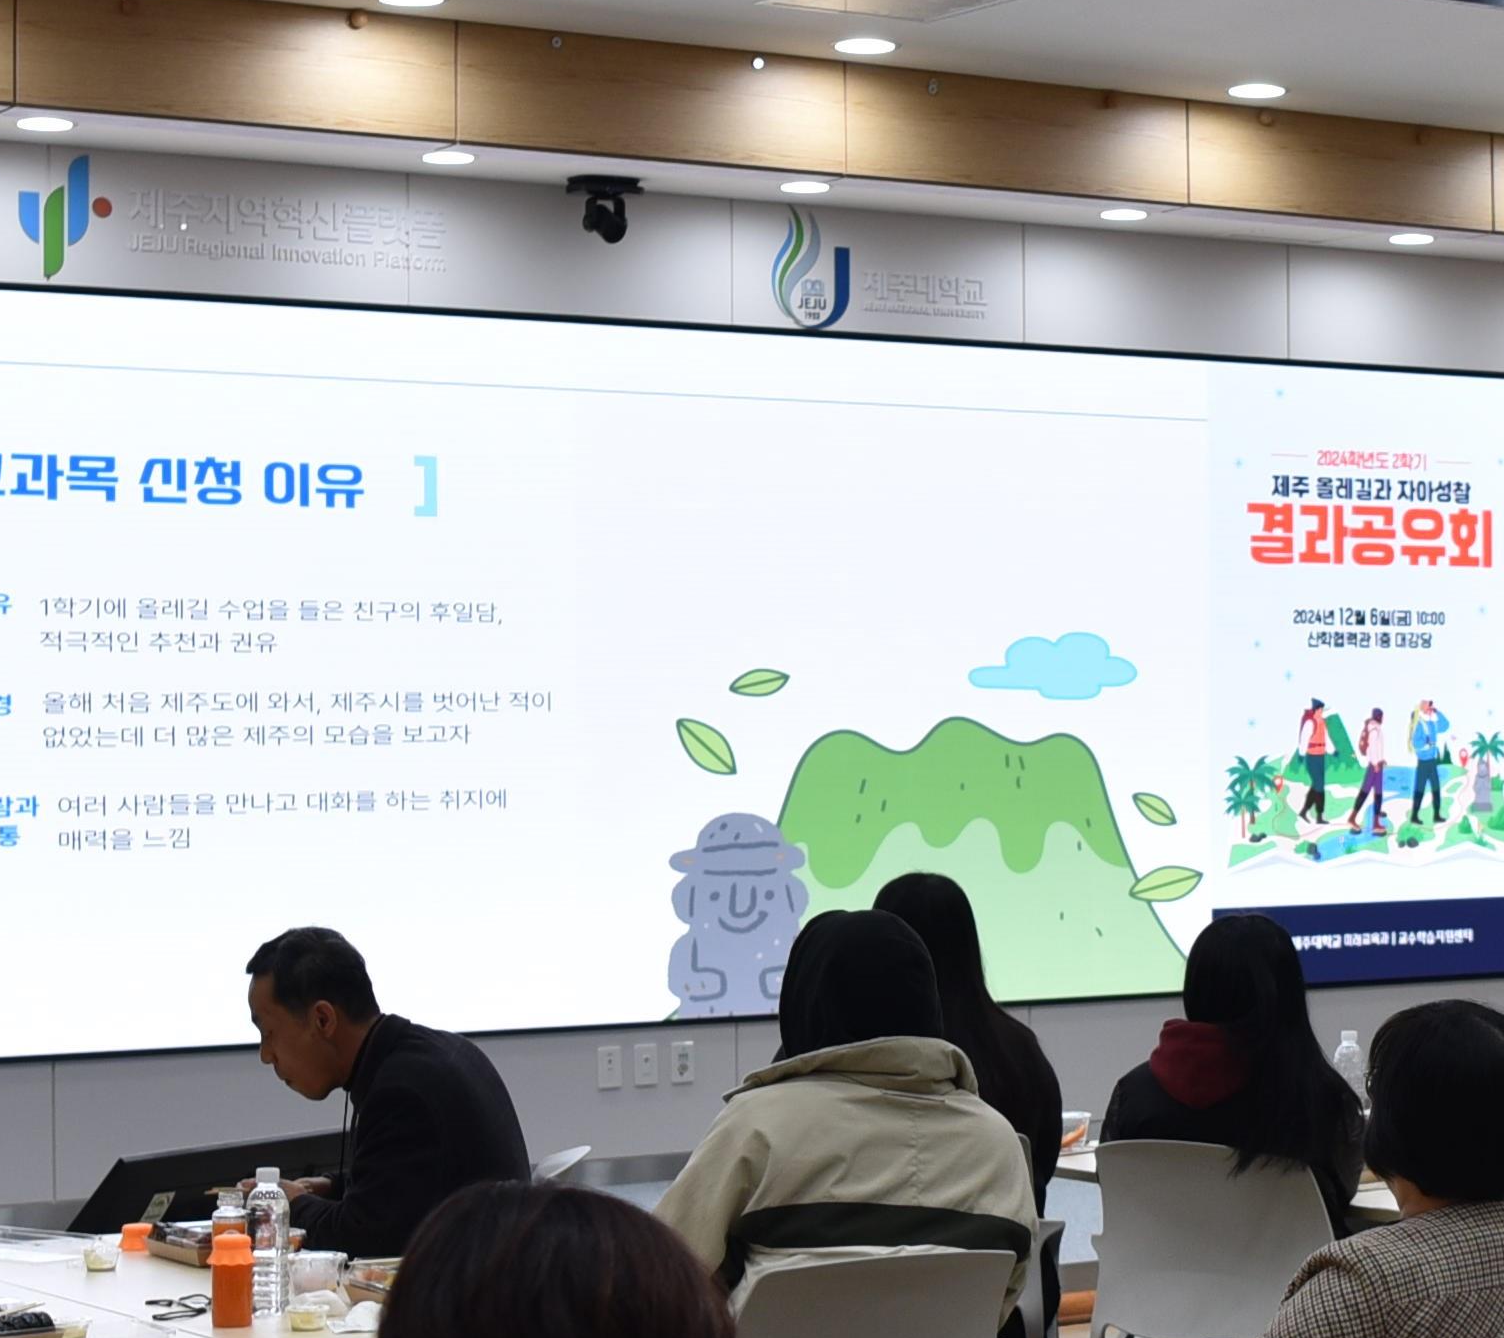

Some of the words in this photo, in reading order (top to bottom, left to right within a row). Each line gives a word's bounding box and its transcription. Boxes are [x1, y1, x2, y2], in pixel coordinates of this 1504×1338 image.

[129, 232, 178, 253] JEJU
[183, 235, 265, 261] Regional
[272, 243, 366, 268] Innovation
[864, 271, 988, 307] 제주대학교
[798, 296, 827, 311] JEJU
[1317, 449, 1389, 470] 2024학년도
[1392, 453, 1428, 472] 2학기
[139, 456, 243, 507] 신청
[263, 460, 365, 509] 이유
[1272, 474, 1310, 499] 제주
[1316, 476, 1392, 502] 올레길과
[1398, 479, 1471, 505] 자아성찰
[1247, 502, 1492, 568] 결과공유회
[40, 597, 127, 619] 1학기에
[136, 597, 209, 621] 올레길
[217, 598, 290, 622] 수업을
[298, 599, 344, 622] 들은
[353, 600, 420, 623] 친구의
[429, 601, 503, 626] 후일담,
[1293, 609, 1334, 626] 2024년
[1339, 607, 1366, 626] 12월
[1370, 607, 1412, 627] 6일(금)
[1416, 610, 1446, 626] 10:00
[40, 630, 139, 654] 적극적인
[149, 630, 222, 654] 추천과
[230, 631, 279, 654] 권유
[1395, 632, 1432, 649] 대강당
[43, 692, 92, 714] 올해
[102, 692, 151, 714] 처음
[161, 691, 258, 714] 제주도에
[267, 691, 321, 716] 와서,
[330, 691, 424, 713] 제주시를
[433, 691, 501, 713] 벗어난
[509, 690, 552, 713] 적이
[43, 725, 144, 749] 없었는데
[154, 725, 176, 748] 더
[186, 725, 235, 748] 많은
[243, 724, 314, 747] 제주의
[323, 723, 394, 746] 모습을
[402, 723, 471, 746] 보고자
[58, 794, 107, 817] 여러
[117, 793, 216, 817] 사람들을
[226, 791, 298, 815] 만나고
[307, 790, 376, 814] 대화를
[386, 790, 431, 812] 하는
[440, 789, 507, 812] 취지에
[58, 828, 134, 852] 매력을
[143, 826, 191, 850] 느낌
